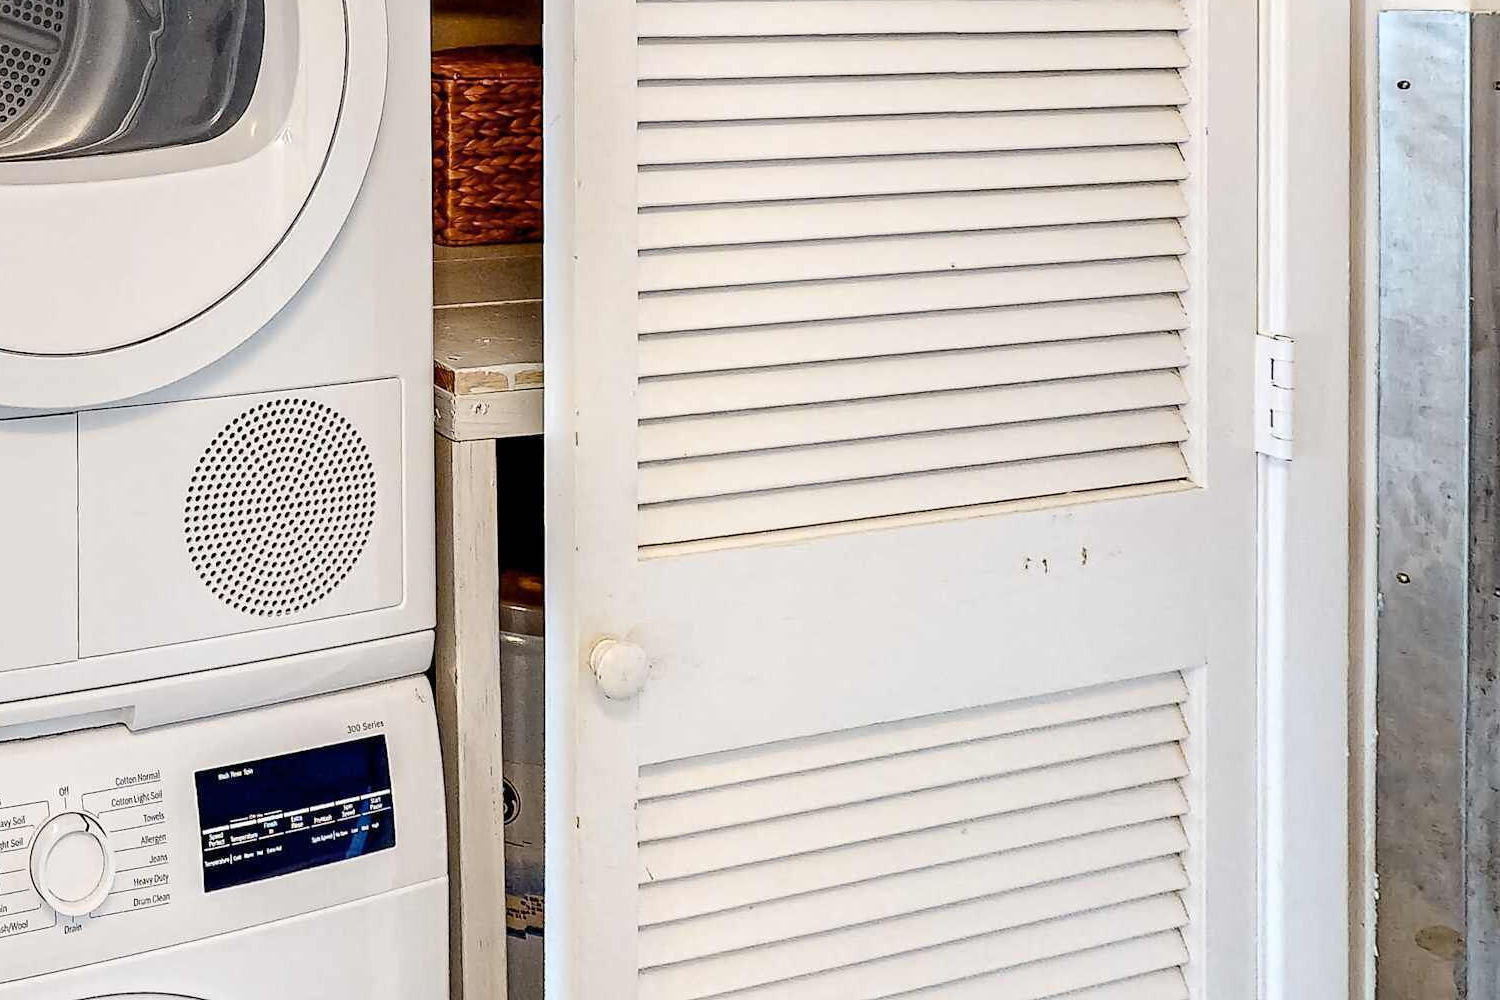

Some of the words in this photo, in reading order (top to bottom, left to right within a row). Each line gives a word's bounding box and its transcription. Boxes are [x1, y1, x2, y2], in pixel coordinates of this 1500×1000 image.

[363, 721, 384, 730] Series
[115, 776, 137, 786] Cotton
[138, 771, 160, 782] Normal
[59, 787, 69, 797] Off
[111, 797, 133, 808] Cotton
[135, 793, 149, 805] Light
[150, 790, 162, 799] Soil
[13, 816, 25, 825] Soil
[144, 812, 164, 823] Towels
[10, 838, 23, 847] Soil
[141, 833, 166, 845] Allergen
[149, 854, 168, 864] Jeans
[133, 876, 153, 887] Heavy
[154, 873, 169, 885] Duty
[133, 896, 151, 907] Drum
[151, 893, 170, 904] Clean
[64, 924, 82, 935] Drain
